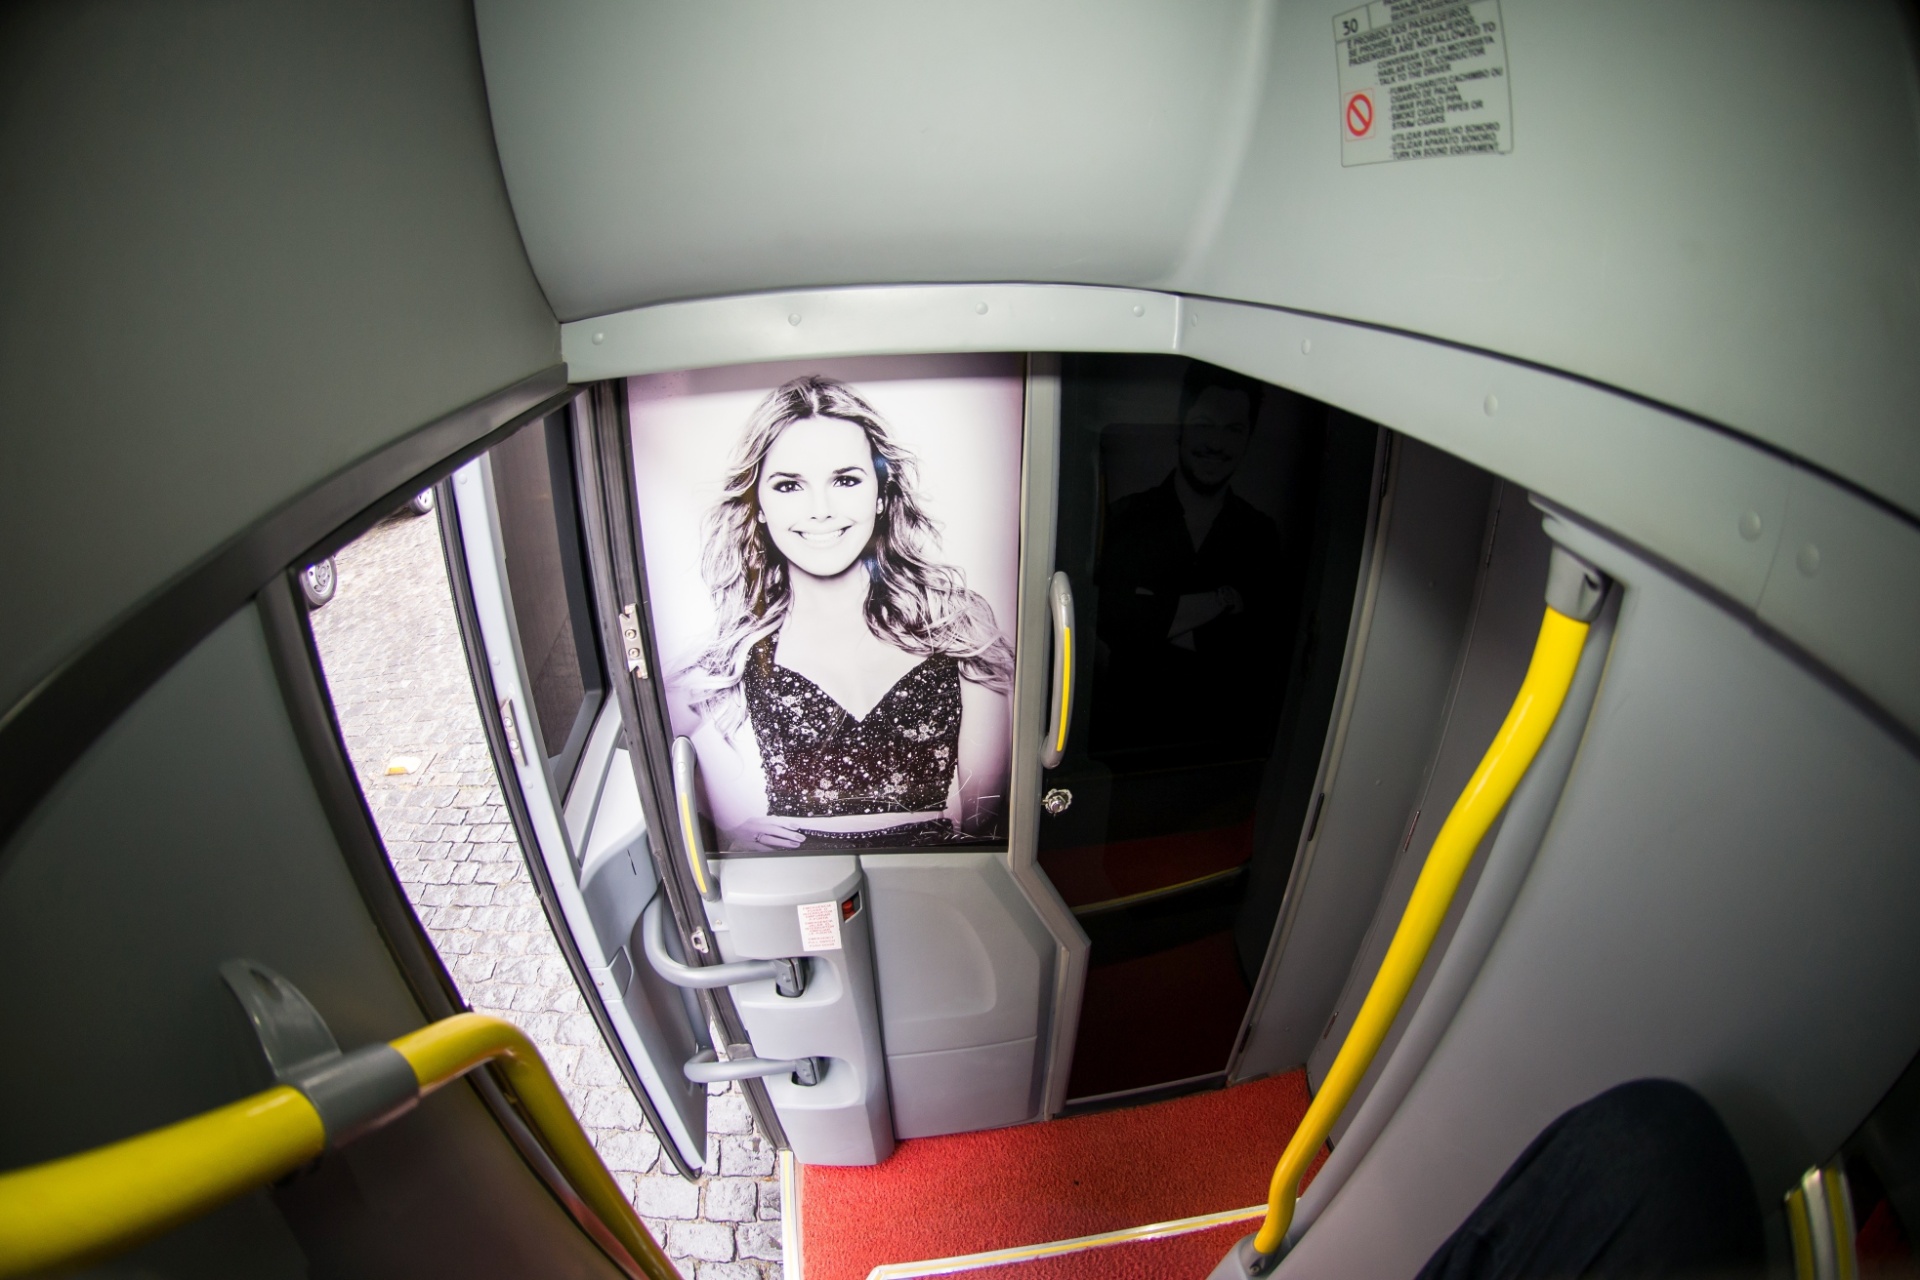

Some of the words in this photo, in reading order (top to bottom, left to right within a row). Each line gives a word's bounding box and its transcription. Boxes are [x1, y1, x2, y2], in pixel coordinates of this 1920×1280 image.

[1354, 28, 1389, 46] PROIBIDO
[1391, 24, 1406, 34] AOS
[1409, 5, 1470, 28] PASSAGEIROS
[1349, 49, 1356, 58] SE
[1360, 38, 1392, 54] PROHIBE
[1396, 36, 1400, 44] A
[1402, 30, 1419, 42] LOS
[1421, 16, 1475, 35] PASAJEROS
[1349, 46, 1397, 67] PASSENGERS
[1399, 41, 1414, 52] ARE
[1416, 36, 1433, 48] NOT
[1436, 24, 1480, 43] ALLOWED
[1482, 22, 1496, 34] TO
[1378, 52, 1420, 69] CONVERSAR
[1421, 48, 1438, 58] COM
[1440, 46, 1446, 54] O
[1448, 36, 1494, 51] MOTORISTA
[1378, 64, 1405, 78] HABLAR
[1407, 60, 1422, 71] CON
[1435, 46, 1486, 64] CONDUCTOR
[1380, 76, 1396, 86] TALK
[1398, 73, 1406, 81] TO
[1408, 70, 1421, 78] THE
[1424, 63, 1451, 76] DRIVER
[1390, 84, 1412, 94] FUMAR
[1414, 77, 1447, 90] CHARUTO
[1450, 68, 1490, 84] CACHIMBO
[1491, 66, 1502, 77] OU
[1391, 91, 1421, 104] CIGARRO
[1423, 88, 1432, 98] DE
[1434, 84, 1458, 94] PALHA
[1391, 102, 1414, 112] FUMAR
[1416, 98, 1436, 108] PURO
[1438, 96, 1444, 105] O
[1446, 93, 1462, 102] PIPA
[1392, 110, 1414, 122] SMOKE
[1417, 106, 1444, 116] CIGARS
[1447, 102, 1469, 112] PIPES
[1471, 100, 1483, 110] OR
[1392, 120, 1414, 130] STRAW
[1417, 114, 1445, 126] CIGARS
[1392, 131, 1422, 143] UTILIZAR
[1424, 126, 1463, 136] APARELHO
[1392, 140, 1422, 151] UTILIZAR
[1424, 135, 1459, 146] APARATO
[1393, 150, 1410, 160] TURN
[1412, 150, 1422, 158] ON
[1424, 146, 1448, 157] SOUND
